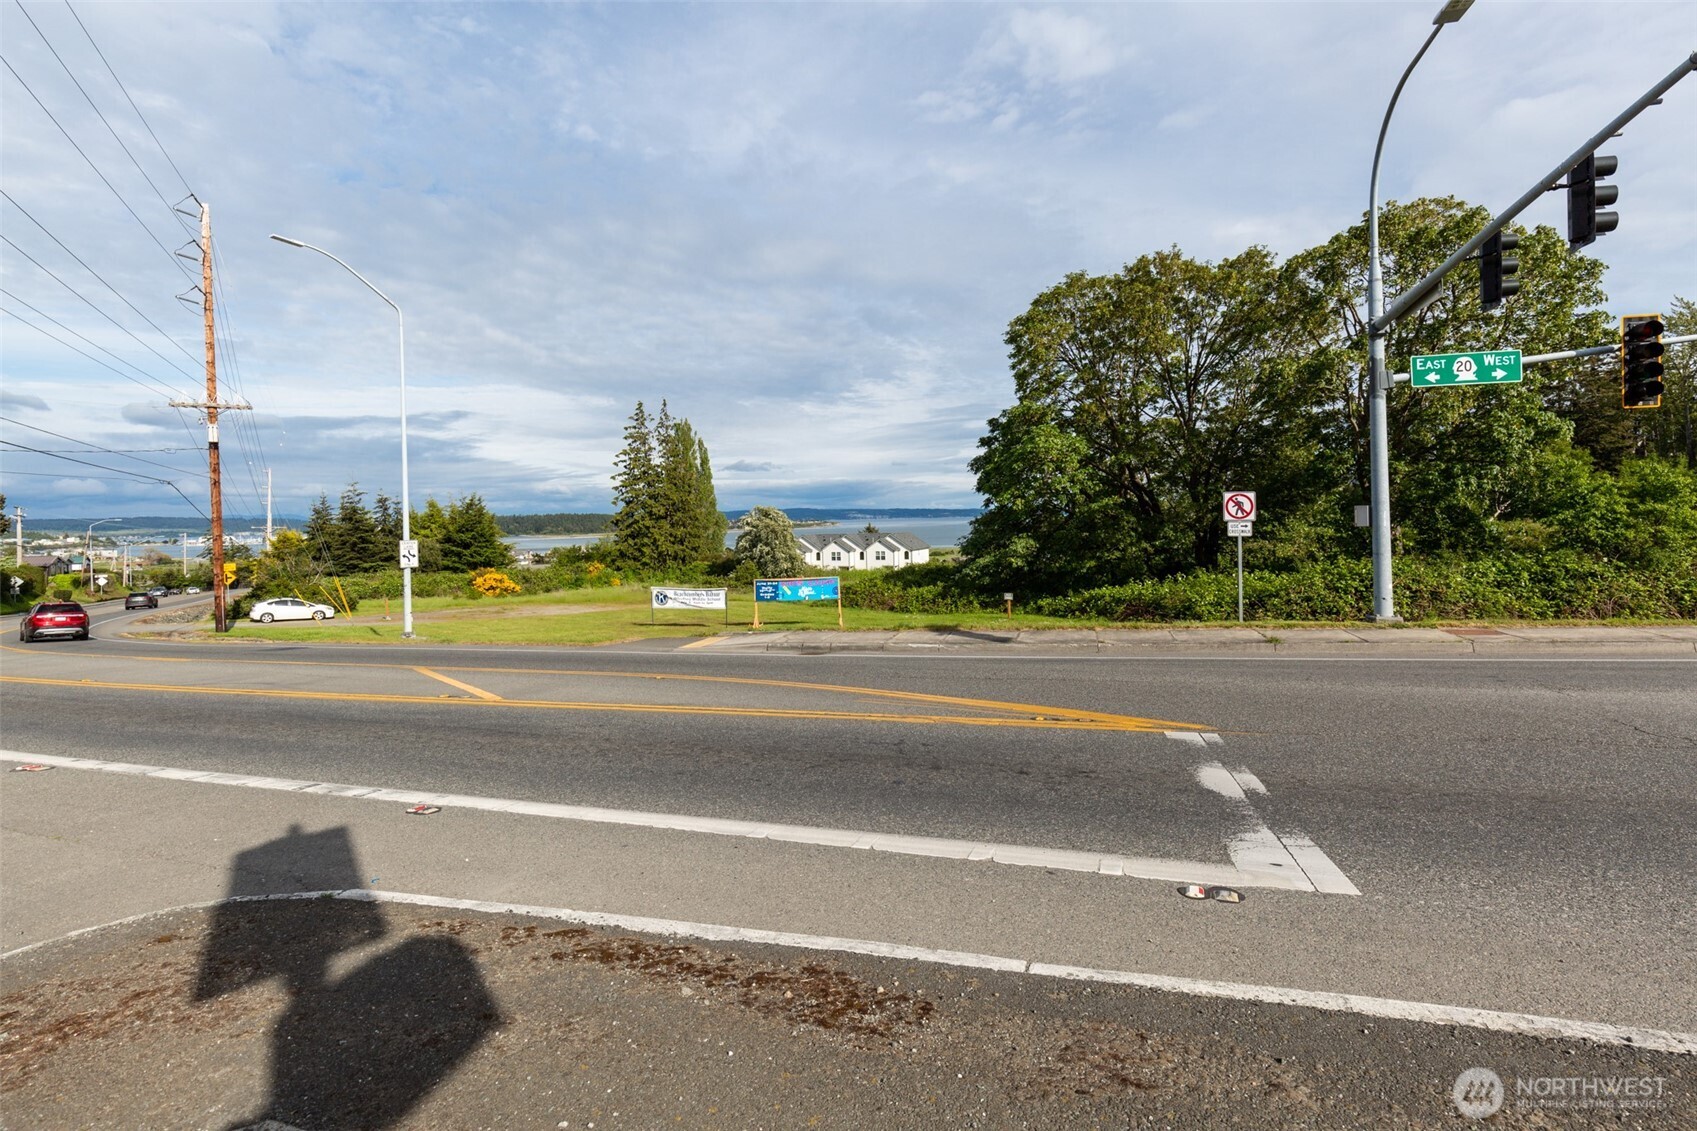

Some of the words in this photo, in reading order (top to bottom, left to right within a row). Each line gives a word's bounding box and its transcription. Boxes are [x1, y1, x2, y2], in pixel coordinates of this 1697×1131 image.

[1416, 358, 1446, 370] EAST
[1455, 360, 1472, 372] 20
[1483, 354, 1516, 366] WEST
